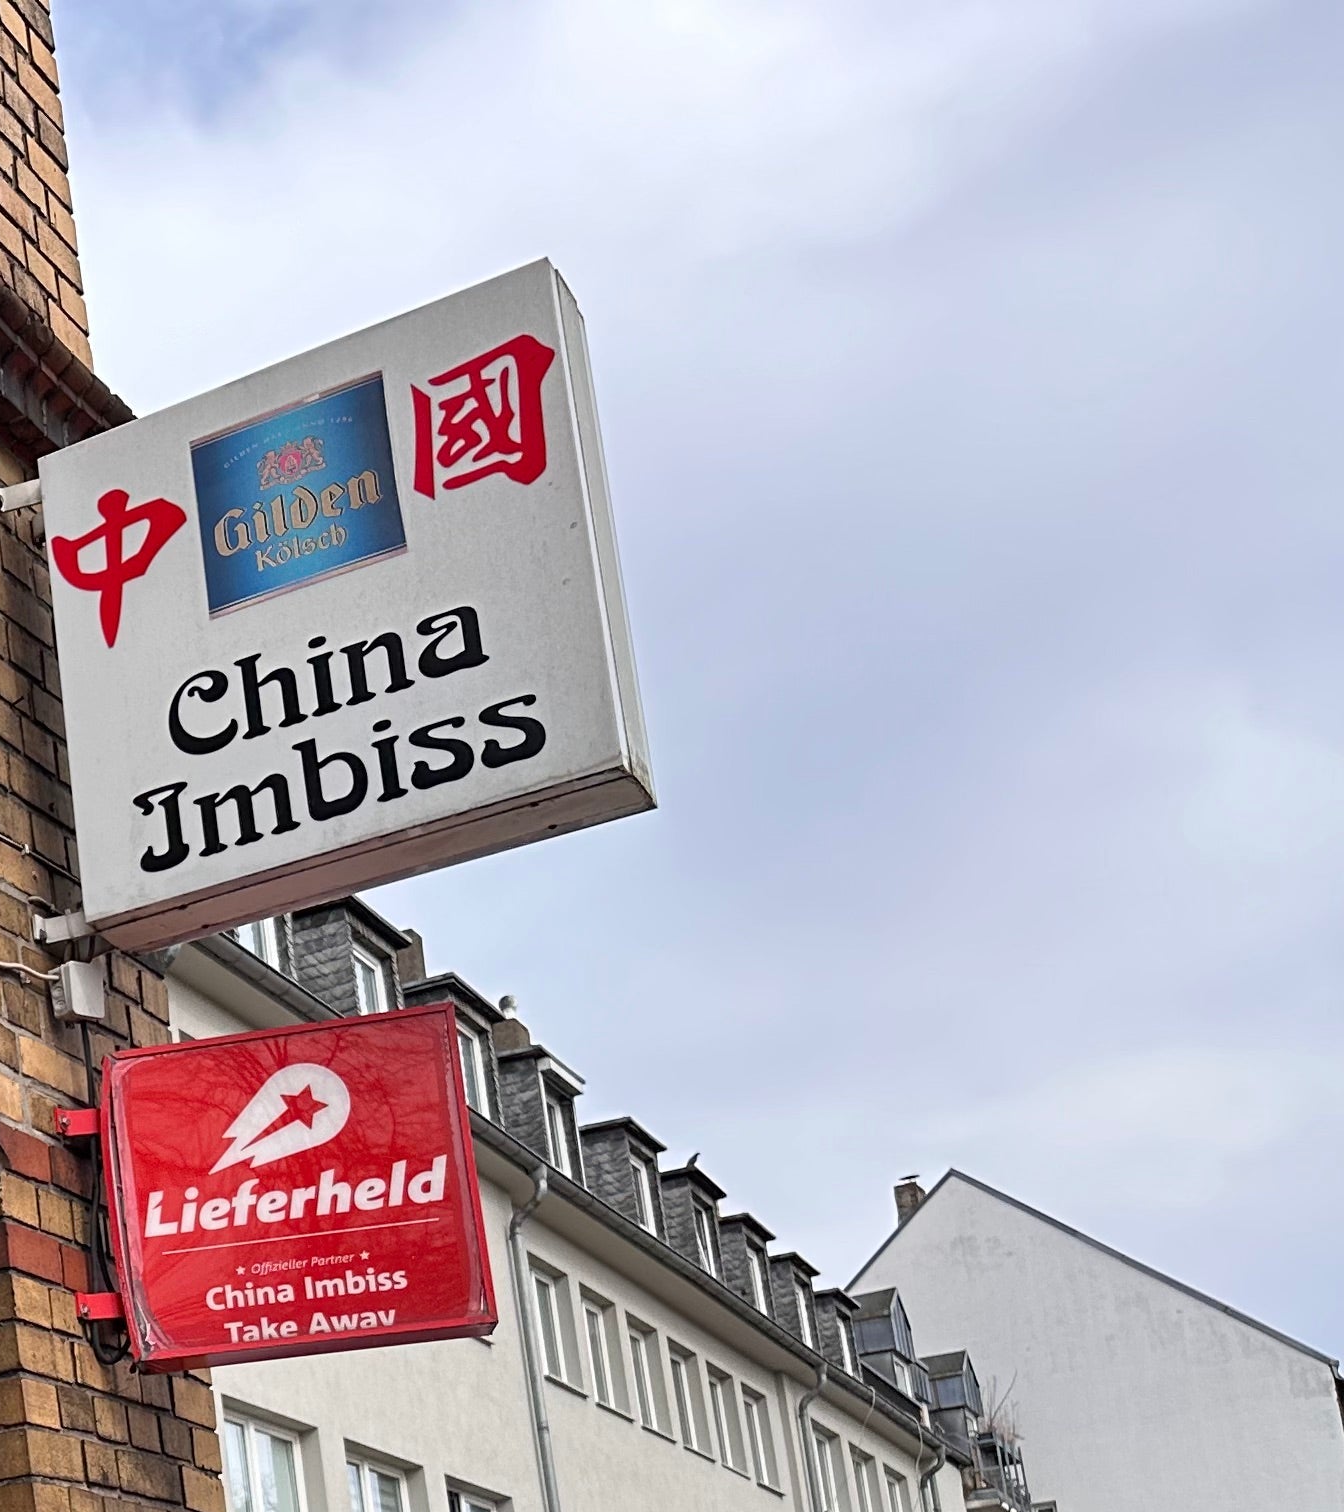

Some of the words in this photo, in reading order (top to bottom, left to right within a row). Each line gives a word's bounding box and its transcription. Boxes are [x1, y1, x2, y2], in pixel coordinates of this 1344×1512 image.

[214, 469, 383, 557] Gilden
[51, 488, 187, 650] 中
[255, 523, 349, 572] Kölsch
[167, 605, 490, 756] China
[144, 1153, 448, 1238] Lieferheld
[205, 1281, 295, 1311] China
[304, 1267, 408, 1300] Imbiss
[251, 1257, 308, 1276] Offizieller
[311, 1253, 355, 1267] Partner
[223, 1317, 298, 1344] Take
